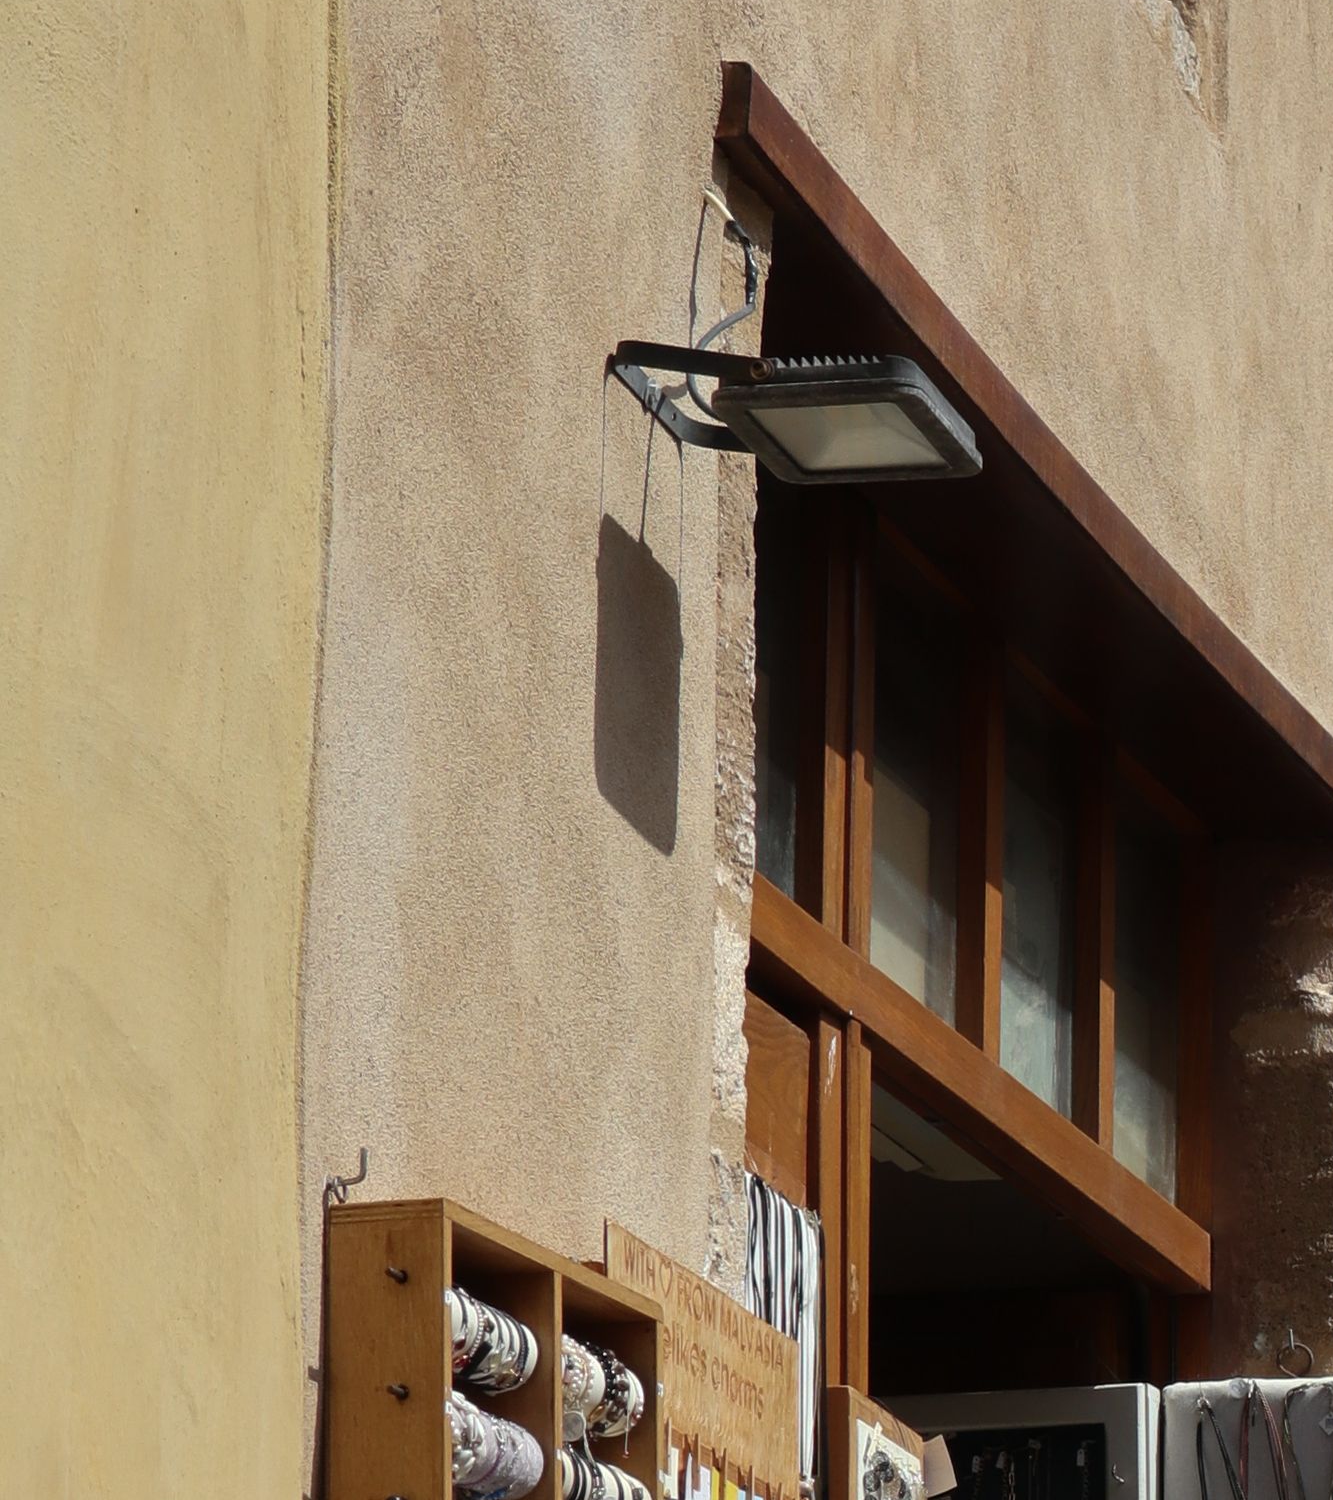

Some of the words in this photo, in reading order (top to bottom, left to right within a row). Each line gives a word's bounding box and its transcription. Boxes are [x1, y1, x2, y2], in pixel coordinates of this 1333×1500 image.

[624, 1239, 656, 1292] WITH
[677, 1271, 716, 1331] FROM
[719, 1305, 785, 1374] MALVASIA
